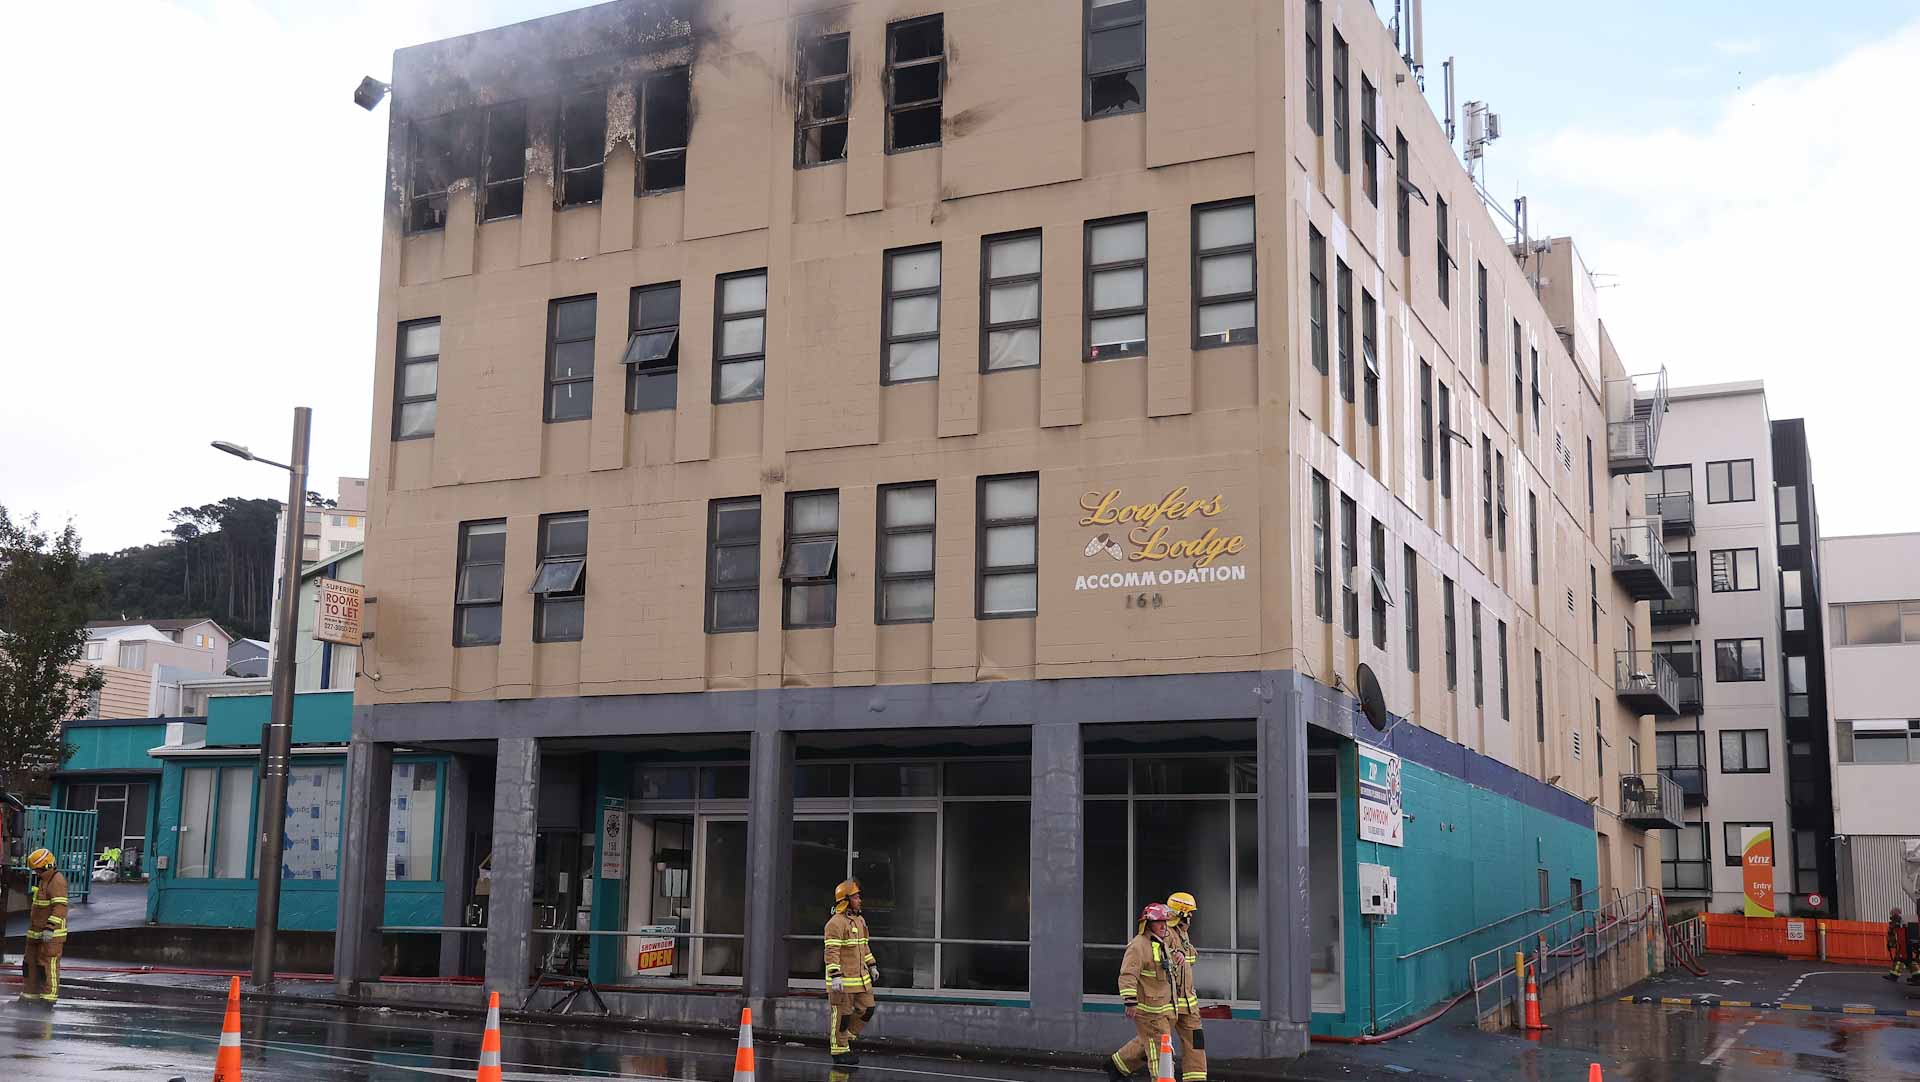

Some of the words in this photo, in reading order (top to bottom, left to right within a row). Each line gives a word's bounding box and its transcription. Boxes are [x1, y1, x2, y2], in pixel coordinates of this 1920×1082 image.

[1079, 486, 1224, 527] Loafers
[1128, 526, 1246, 568] Lodge
[1075, 565, 1246, 591] ACCOMMODATION
[326, 583, 359, 594] SUPERIOR
[326, 593, 359, 607] ROOMS
[325, 603, 339, 615] TO
[342, 606, 358, 618] LET
[1363, 806, 1389, 826] SHOWROOM
[1748, 855, 1770, 864] vtnz
[1753, 882, 1772, 891] Entry
[1811, 896, 1819, 904] 10
[641, 940, 673, 951] SHOWROOM
[640, 949, 673, 969] OPEN
